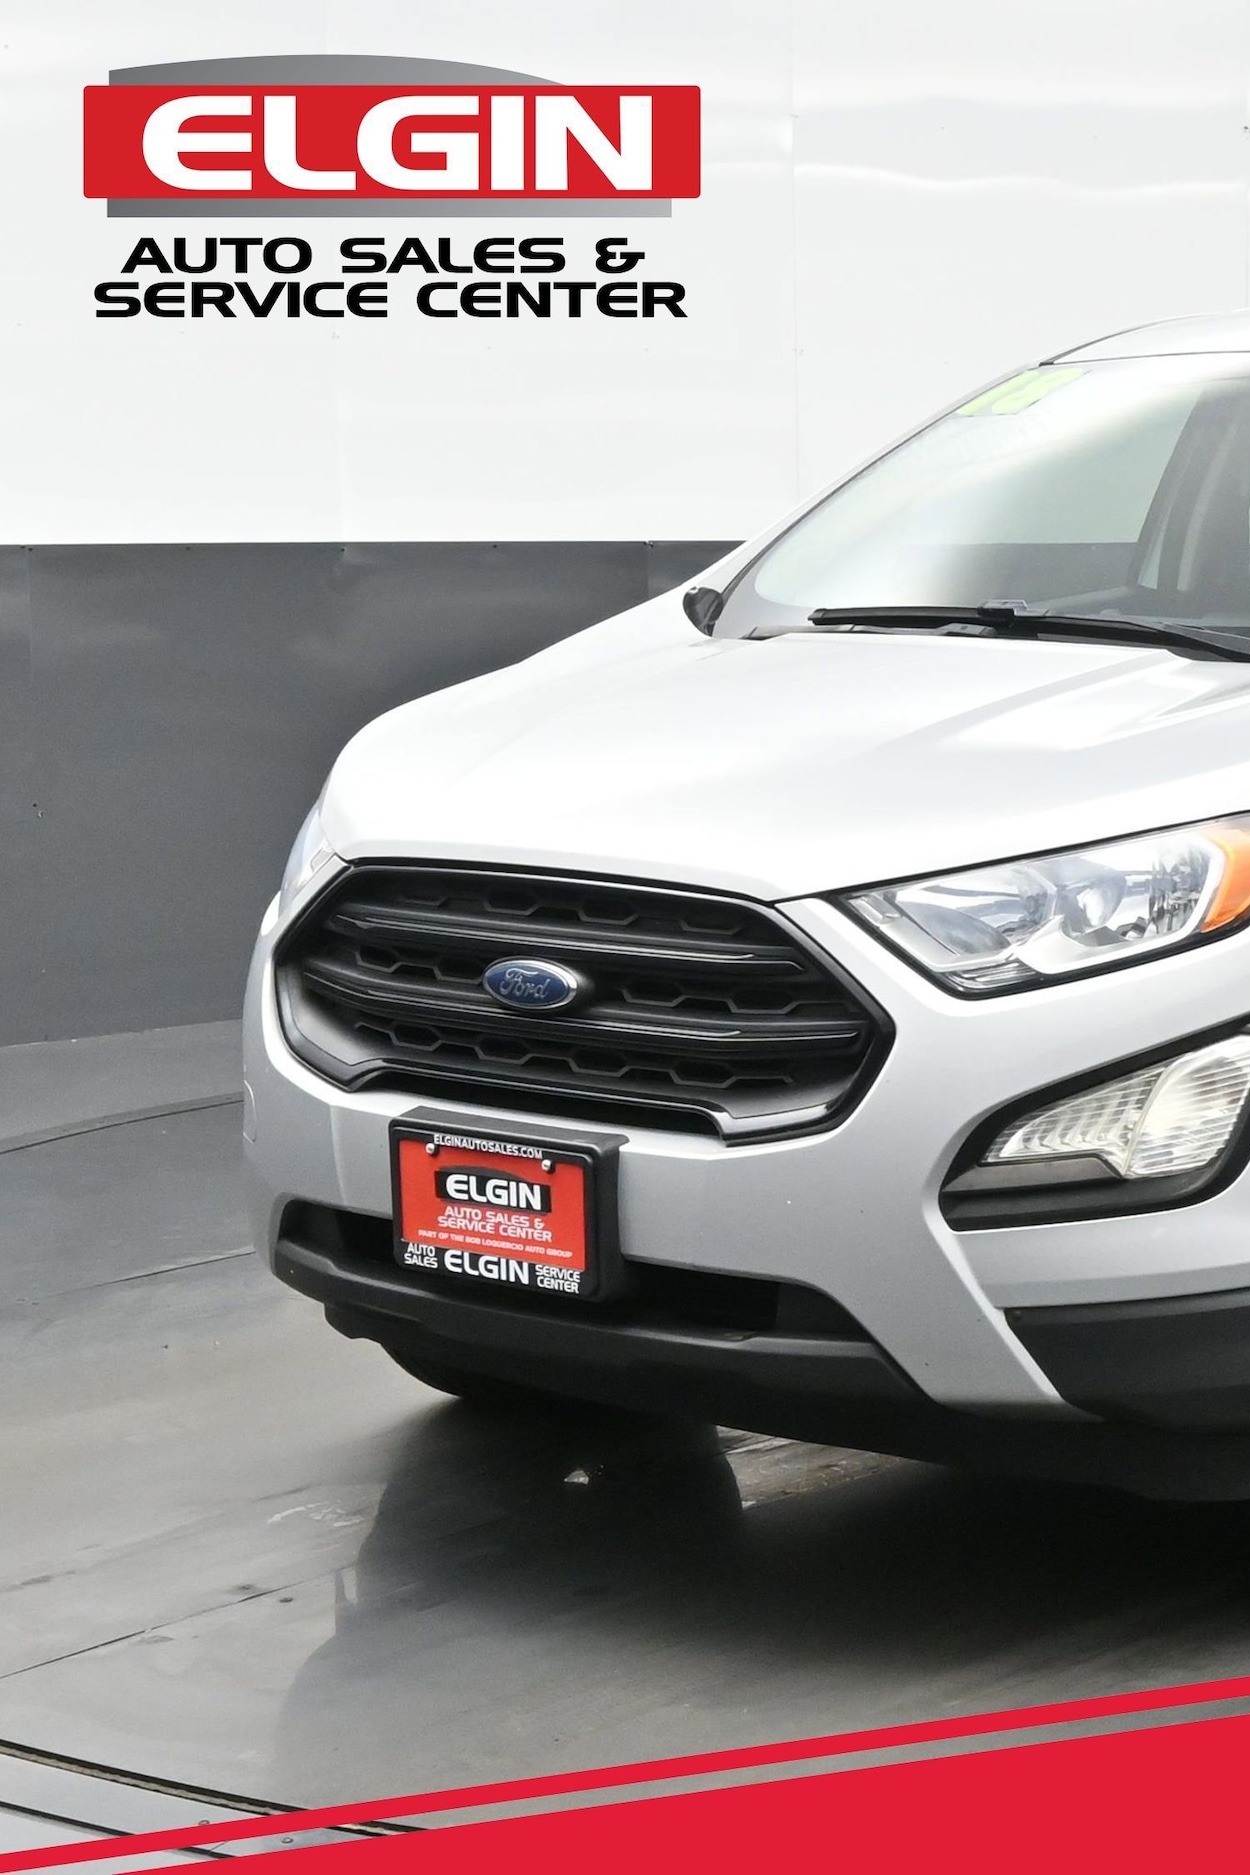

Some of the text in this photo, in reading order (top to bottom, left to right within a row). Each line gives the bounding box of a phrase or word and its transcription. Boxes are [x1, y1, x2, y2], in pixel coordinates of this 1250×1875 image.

[500, 967, 551, 999] Ford
[434, 1134, 543, 1159] ELGINAUTOSALES.COM
[446, 1174, 541, 1210] ELGIN
[438, 1216, 552, 1242] SERVICE CENTER
[444, 1206, 545, 1230] AUTO SALES &
[418, 1229, 437, 1238] PART
[404, 1253, 438, 1269] SALES
[407, 1243, 435, 1257] AUTO
[444, 1250, 529, 1285] ELGIN
[535, 1265, 580, 1283] SERVICE
[537, 1275, 579, 1294] CENTER
